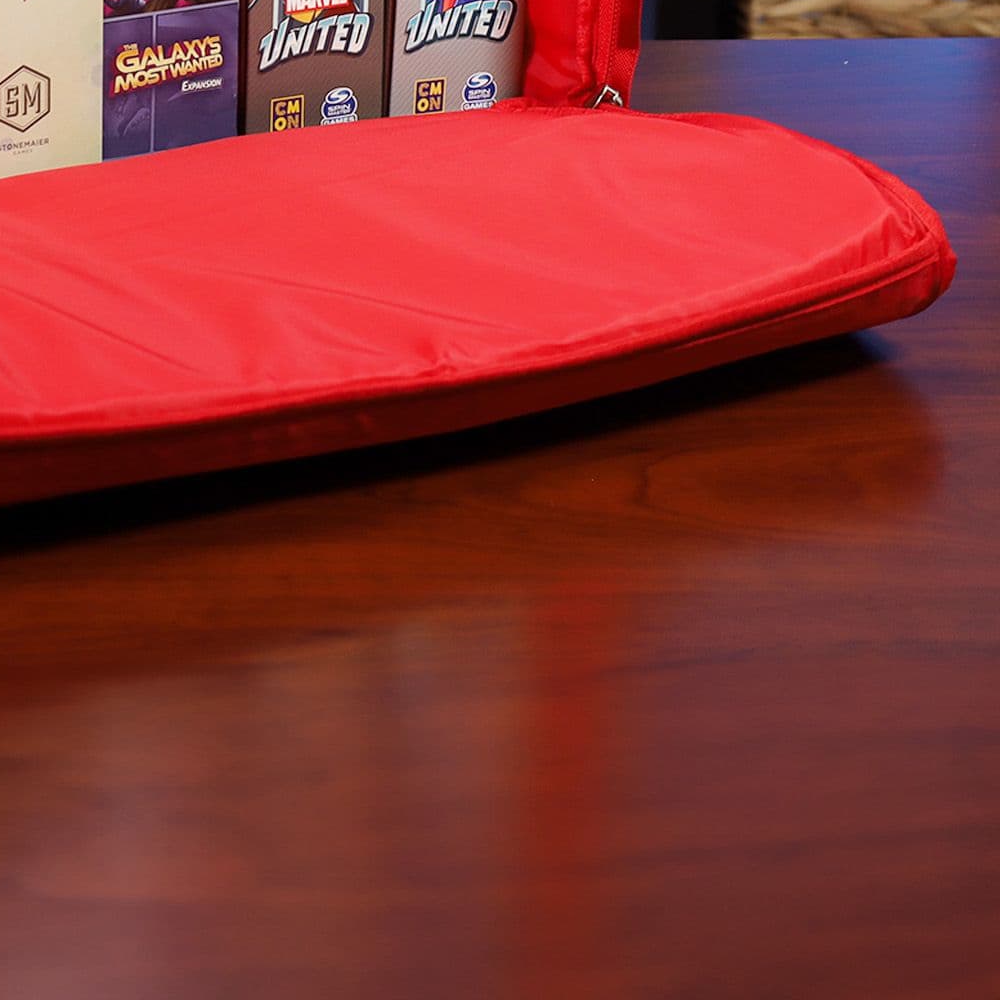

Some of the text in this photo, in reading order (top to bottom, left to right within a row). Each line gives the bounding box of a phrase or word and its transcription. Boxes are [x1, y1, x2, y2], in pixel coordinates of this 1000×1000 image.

[259, 13, 371, 71] UNITED
[405, 0, 514, 52] UNITED
[114, 54, 224, 94] MOST WANTED
[115, 36, 222, 74] GALAXY'S
[274, 101, 300, 117] CM
